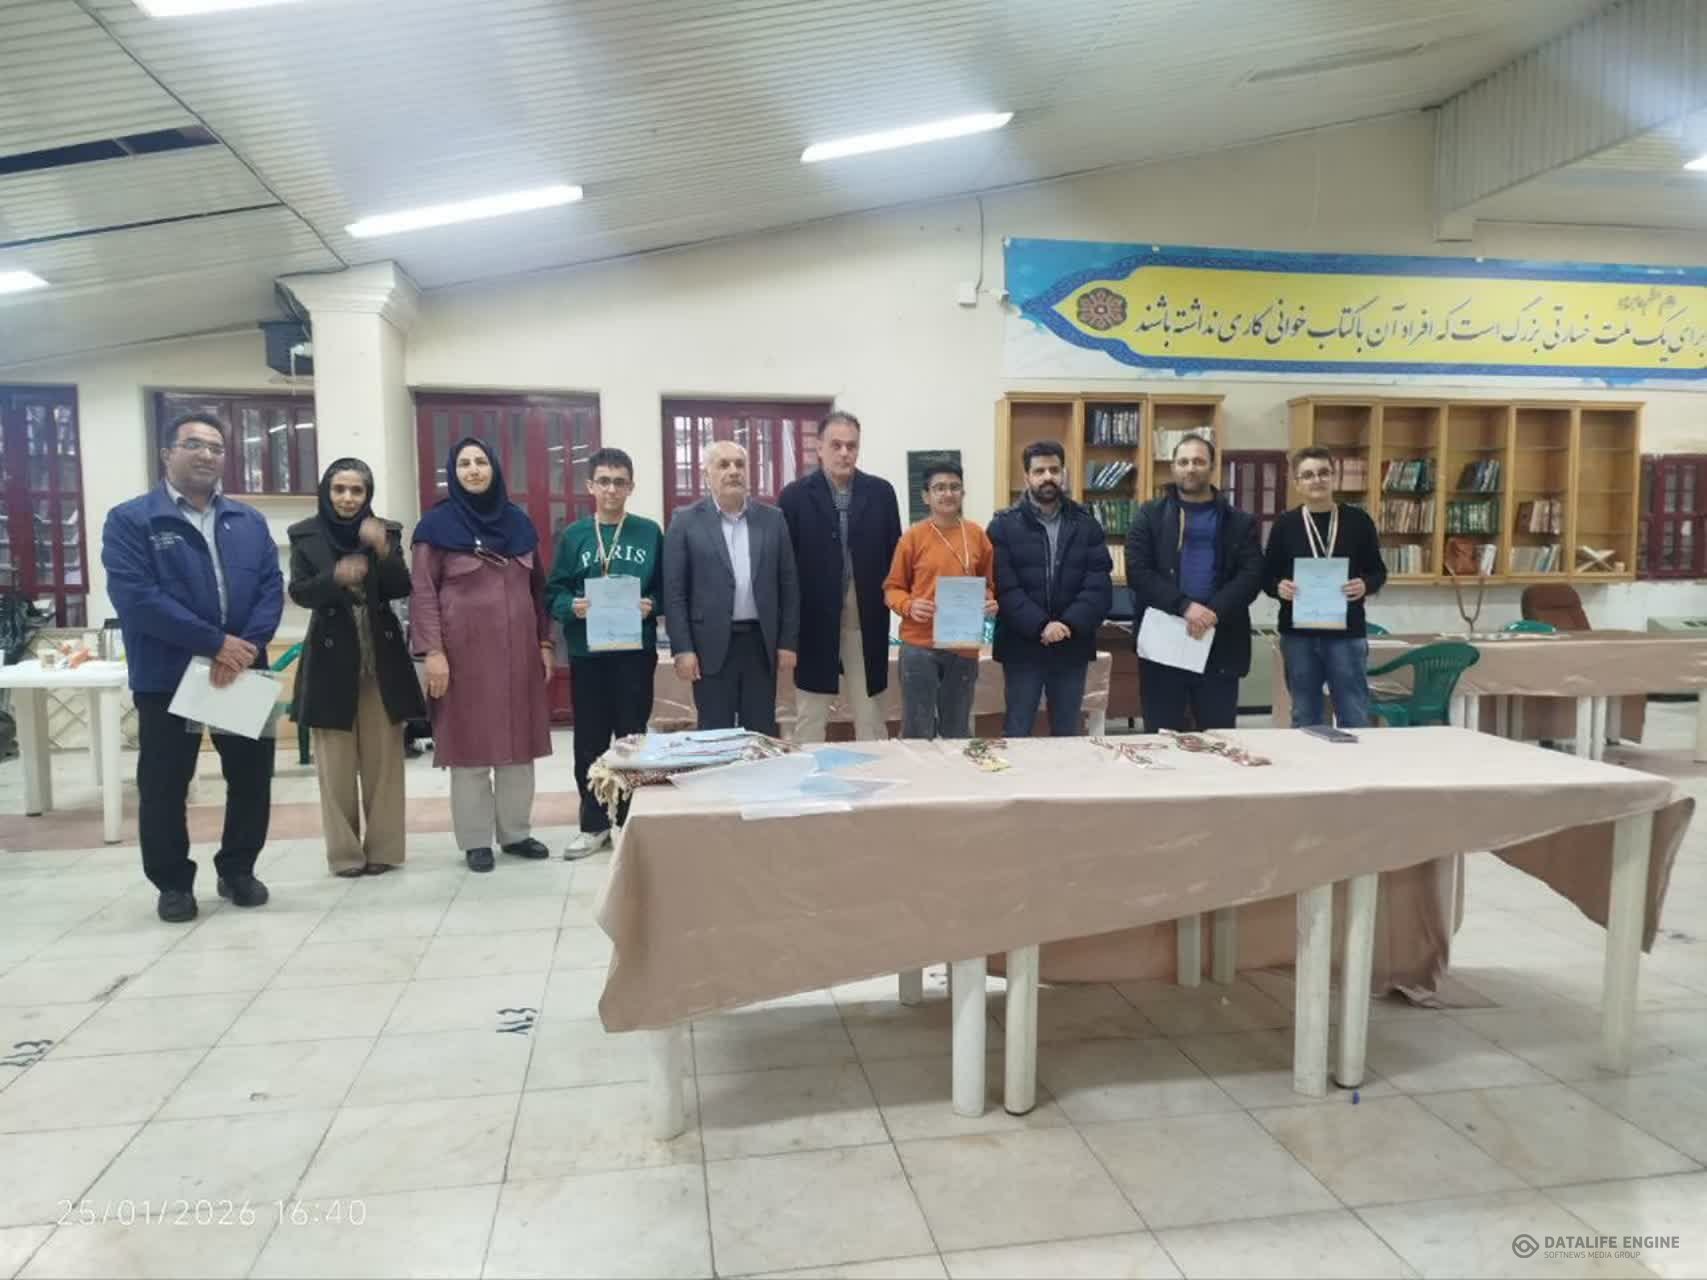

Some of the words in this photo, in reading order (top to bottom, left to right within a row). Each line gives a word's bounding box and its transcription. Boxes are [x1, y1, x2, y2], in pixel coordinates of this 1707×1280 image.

[1133, 294, 1171, 349] باشند
[1171, 297, 1217, 337] نداشته
[1366, 302, 1408, 348] آن
[1400, 307, 1434, 347] افراد
[1435, 296, 1472, 341] که
[1450, 318, 1501, 342] است
[1501, 295, 1542, 354] بزرگ
[1541, 304, 1591, 351] خسارتی
[1593, 318, 1631, 345] ملت
[1632, 304, 1688, 363] یک
[581, 544, 647, 568] PARIS
